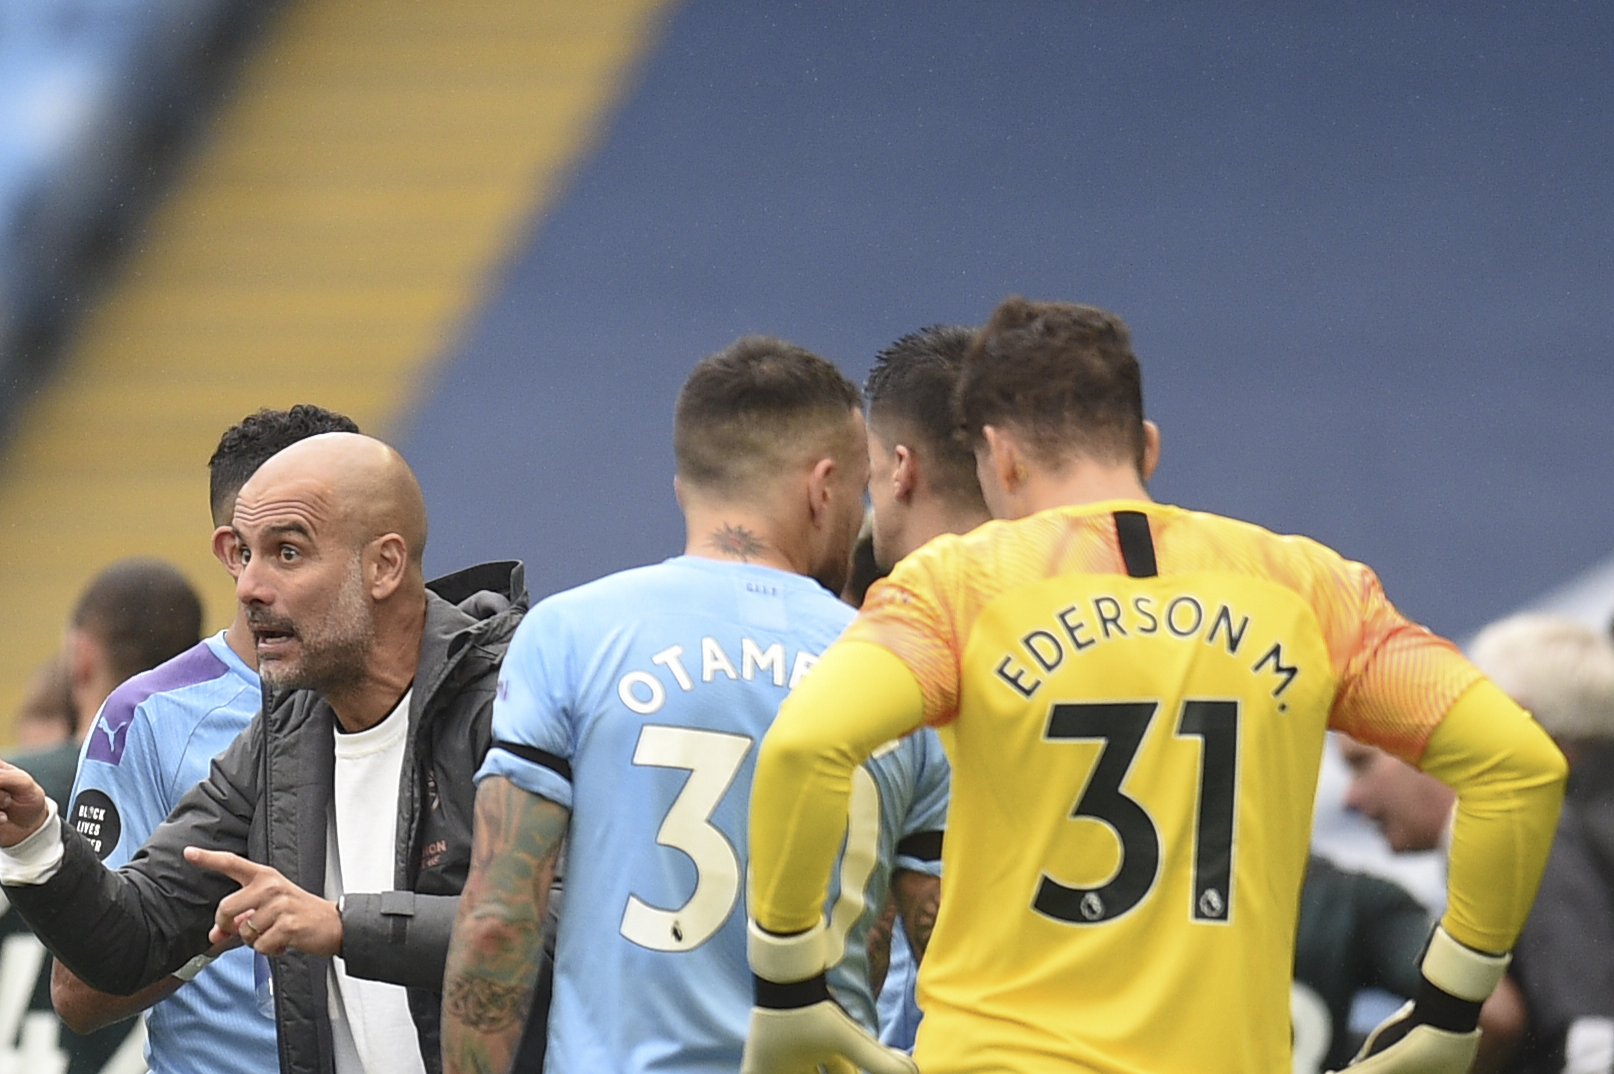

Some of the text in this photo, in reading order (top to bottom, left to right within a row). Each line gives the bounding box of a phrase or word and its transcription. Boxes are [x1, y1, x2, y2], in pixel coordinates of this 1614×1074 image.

[993, 596, 1299, 714] EDERSON M.
[76, 819, 101, 837] LIVES
[1029, 699, 1240, 927] 31
